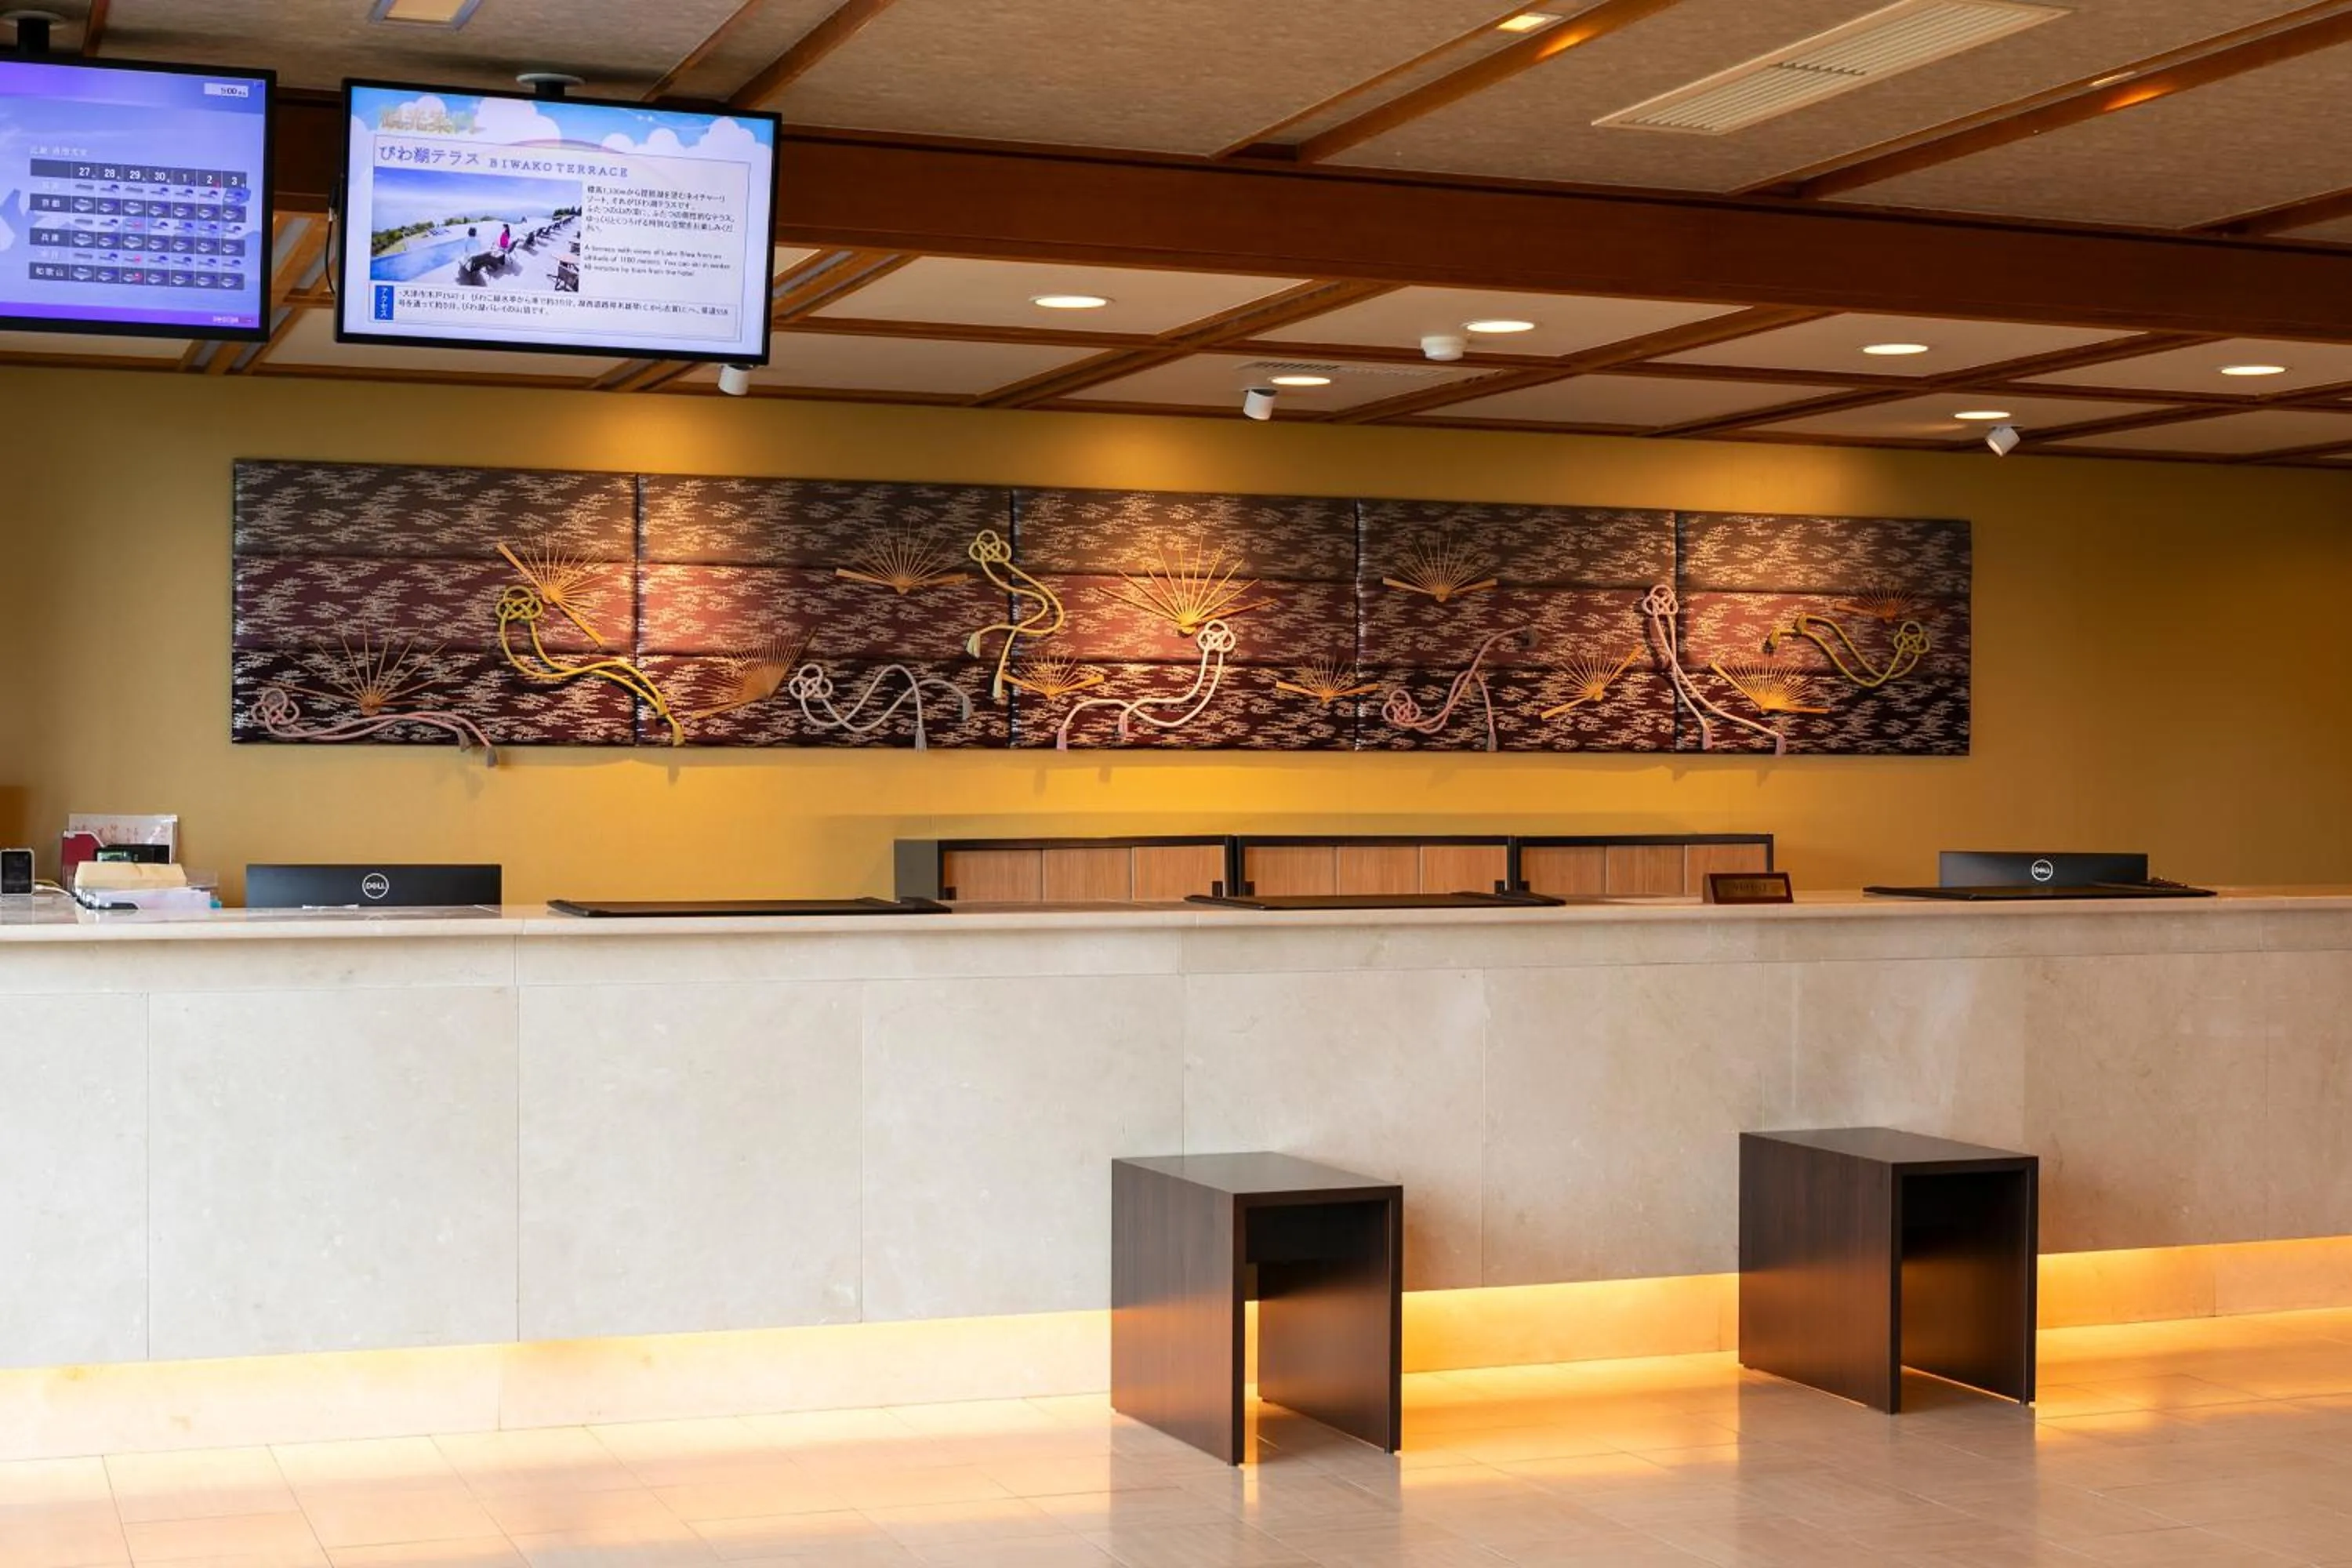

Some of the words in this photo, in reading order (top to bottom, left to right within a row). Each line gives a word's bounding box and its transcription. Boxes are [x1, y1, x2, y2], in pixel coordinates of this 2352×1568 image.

[379, 145, 479, 166] びわ湖テラス
[489, 157, 553, 172] BIWAKO
[556, 162, 628, 178] TERRACE
[79, 167, 90, 176] 27
[104, 169, 115, 178] 28
[129, 169, 141, 180] 29
[154, 172, 165, 181] 30
[206, 175, 212, 183] 2
[231, 176, 238, 185] 3
